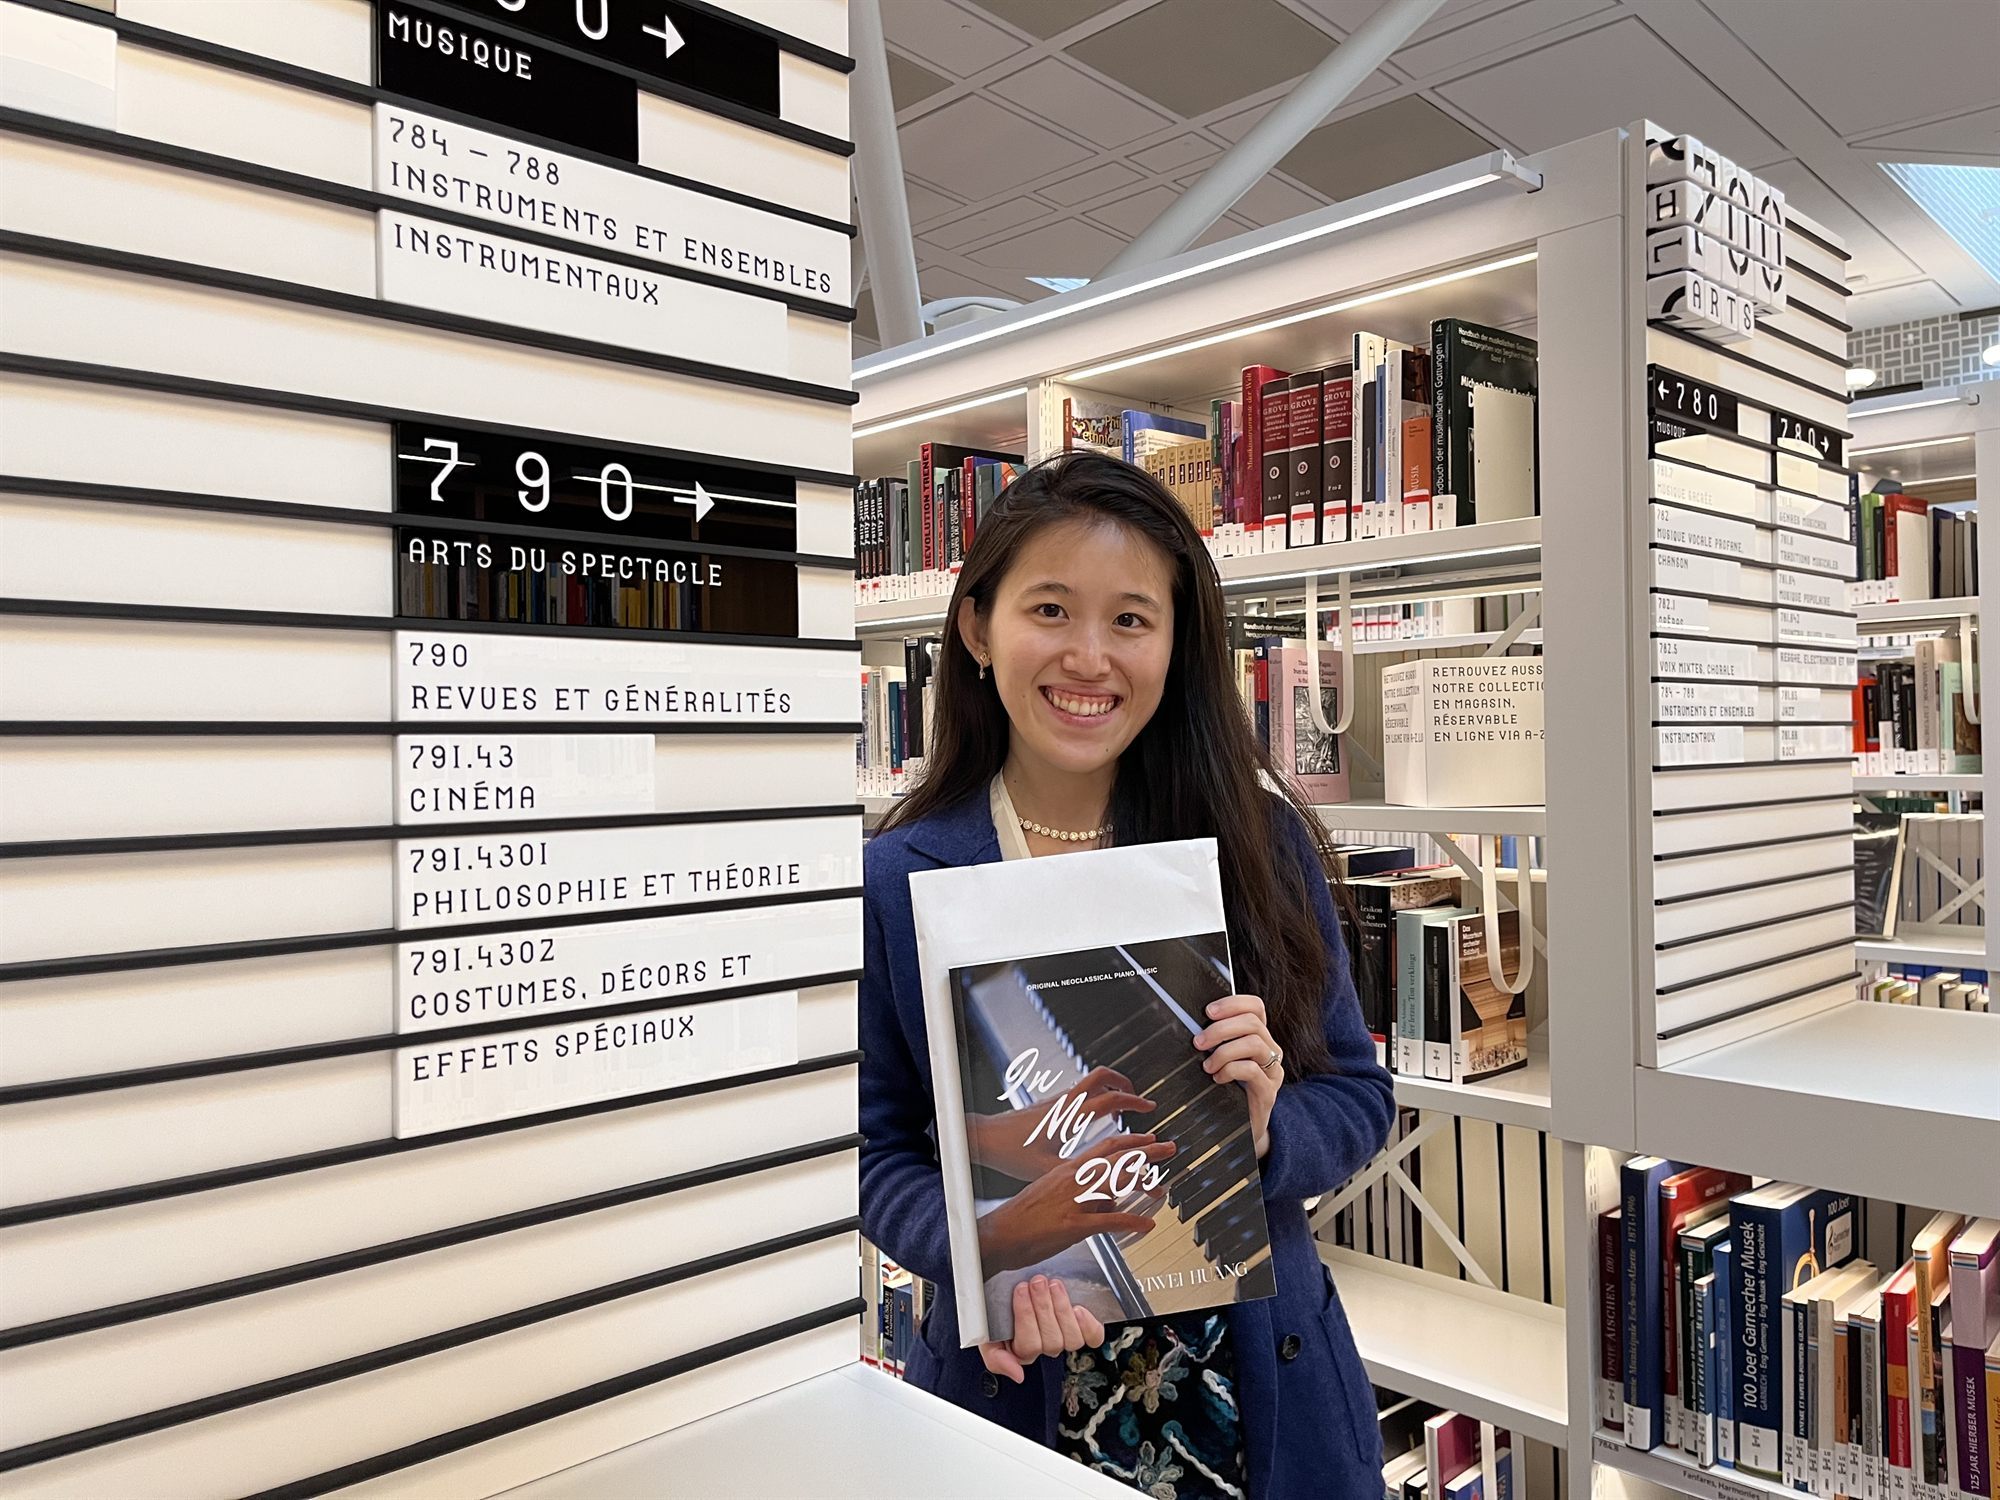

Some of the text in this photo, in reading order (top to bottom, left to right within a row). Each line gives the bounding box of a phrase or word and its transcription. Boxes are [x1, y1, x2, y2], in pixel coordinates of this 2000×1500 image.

[388, 11, 532, 80] MUSIQUE
[390, 117, 448, 156] 784
[507, 151, 560, 185] 788
[391, 162, 832, 293] INSTRUMENTS ET ENSEMBLES
[1694, 154, 1783, 293] 700
[395, 224, 659, 305] INSTRUMENTAUX
[1692, 280, 1752, 330] ARTS
[1435, 343, 1444, 388] Gattungen
[1263, 404, 1288, 415] GROVE
[1290, 398, 1317, 409] GROVE
[1324, 391, 1351, 402] GROVE
[1676, 383, 1717, 421] 780
[1656, 421, 1686, 438] MUSIQUE
[423, 437, 634, 521] 790
[1436, 464, 1444, 496] ndbuch
[922, 446, 932, 568] REVOLUTION TRENET
[1656, 528, 1686, 544] MUSIQUE
[1688, 533, 1713, 548] VOCALE
[409, 538, 723, 586] ARTS DU SPECTACLE
[1657, 556, 1689, 569] CHANSON
[409, 643, 468, 668] 790
[1659, 643, 1678, 655] 782.5
[1433, 665, 1543, 678] RETROUVEZ AUSS
[1659, 662, 1676, 673] VOIX
[411, 684, 791, 714] REVUES ET GÉNÉRALITÉS
[1433, 683, 1474, 693] NOTRE
[1434, 698, 1515, 709] EN MAGASIN,
[1434, 714, 1517, 726] RÉSERVABLE
[1661, 705, 1755, 717] INSTRUMENTS ET ENSEMBLES
[1434, 732, 1450, 742] EN
[1456, 731, 1494, 741] LIGNE
[1499, 730, 1520, 740] VIA
[1661, 733, 1716, 744] INSTRUMENTAUX
[410, 745, 514, 770] 791.43
[410, 781, 536, 812] CINÉMA
[410, 842, 548, 873] 791.4301
[412, 863, 800, 916] PHILOSOPHIE ET THÉORIE
[410, 938, 555, 976] 791.4302
[410, 955, 751, 1020] COSTUMES, DÉCORS ET
[1026, 967, 1158, 992] ORIGINAL NEOCLASSICAL PIANO MUSIC
[412, 1015, 695, 1081] EFFETS SPÉCIAUX
[997, 1047, 1063, 1101] In
[1023, 1091, 1095, 1159] My
[1074, 1150, 1170, 1203] 20s
[1137, 1260, 1248, 1294] YIWEI HUANG
[1739, 1222, 1757, 1408] 100 Joer Garnecher Musek
[1966, 1376, 1980, 1490] 125 JAR HIERBER MUSEK
